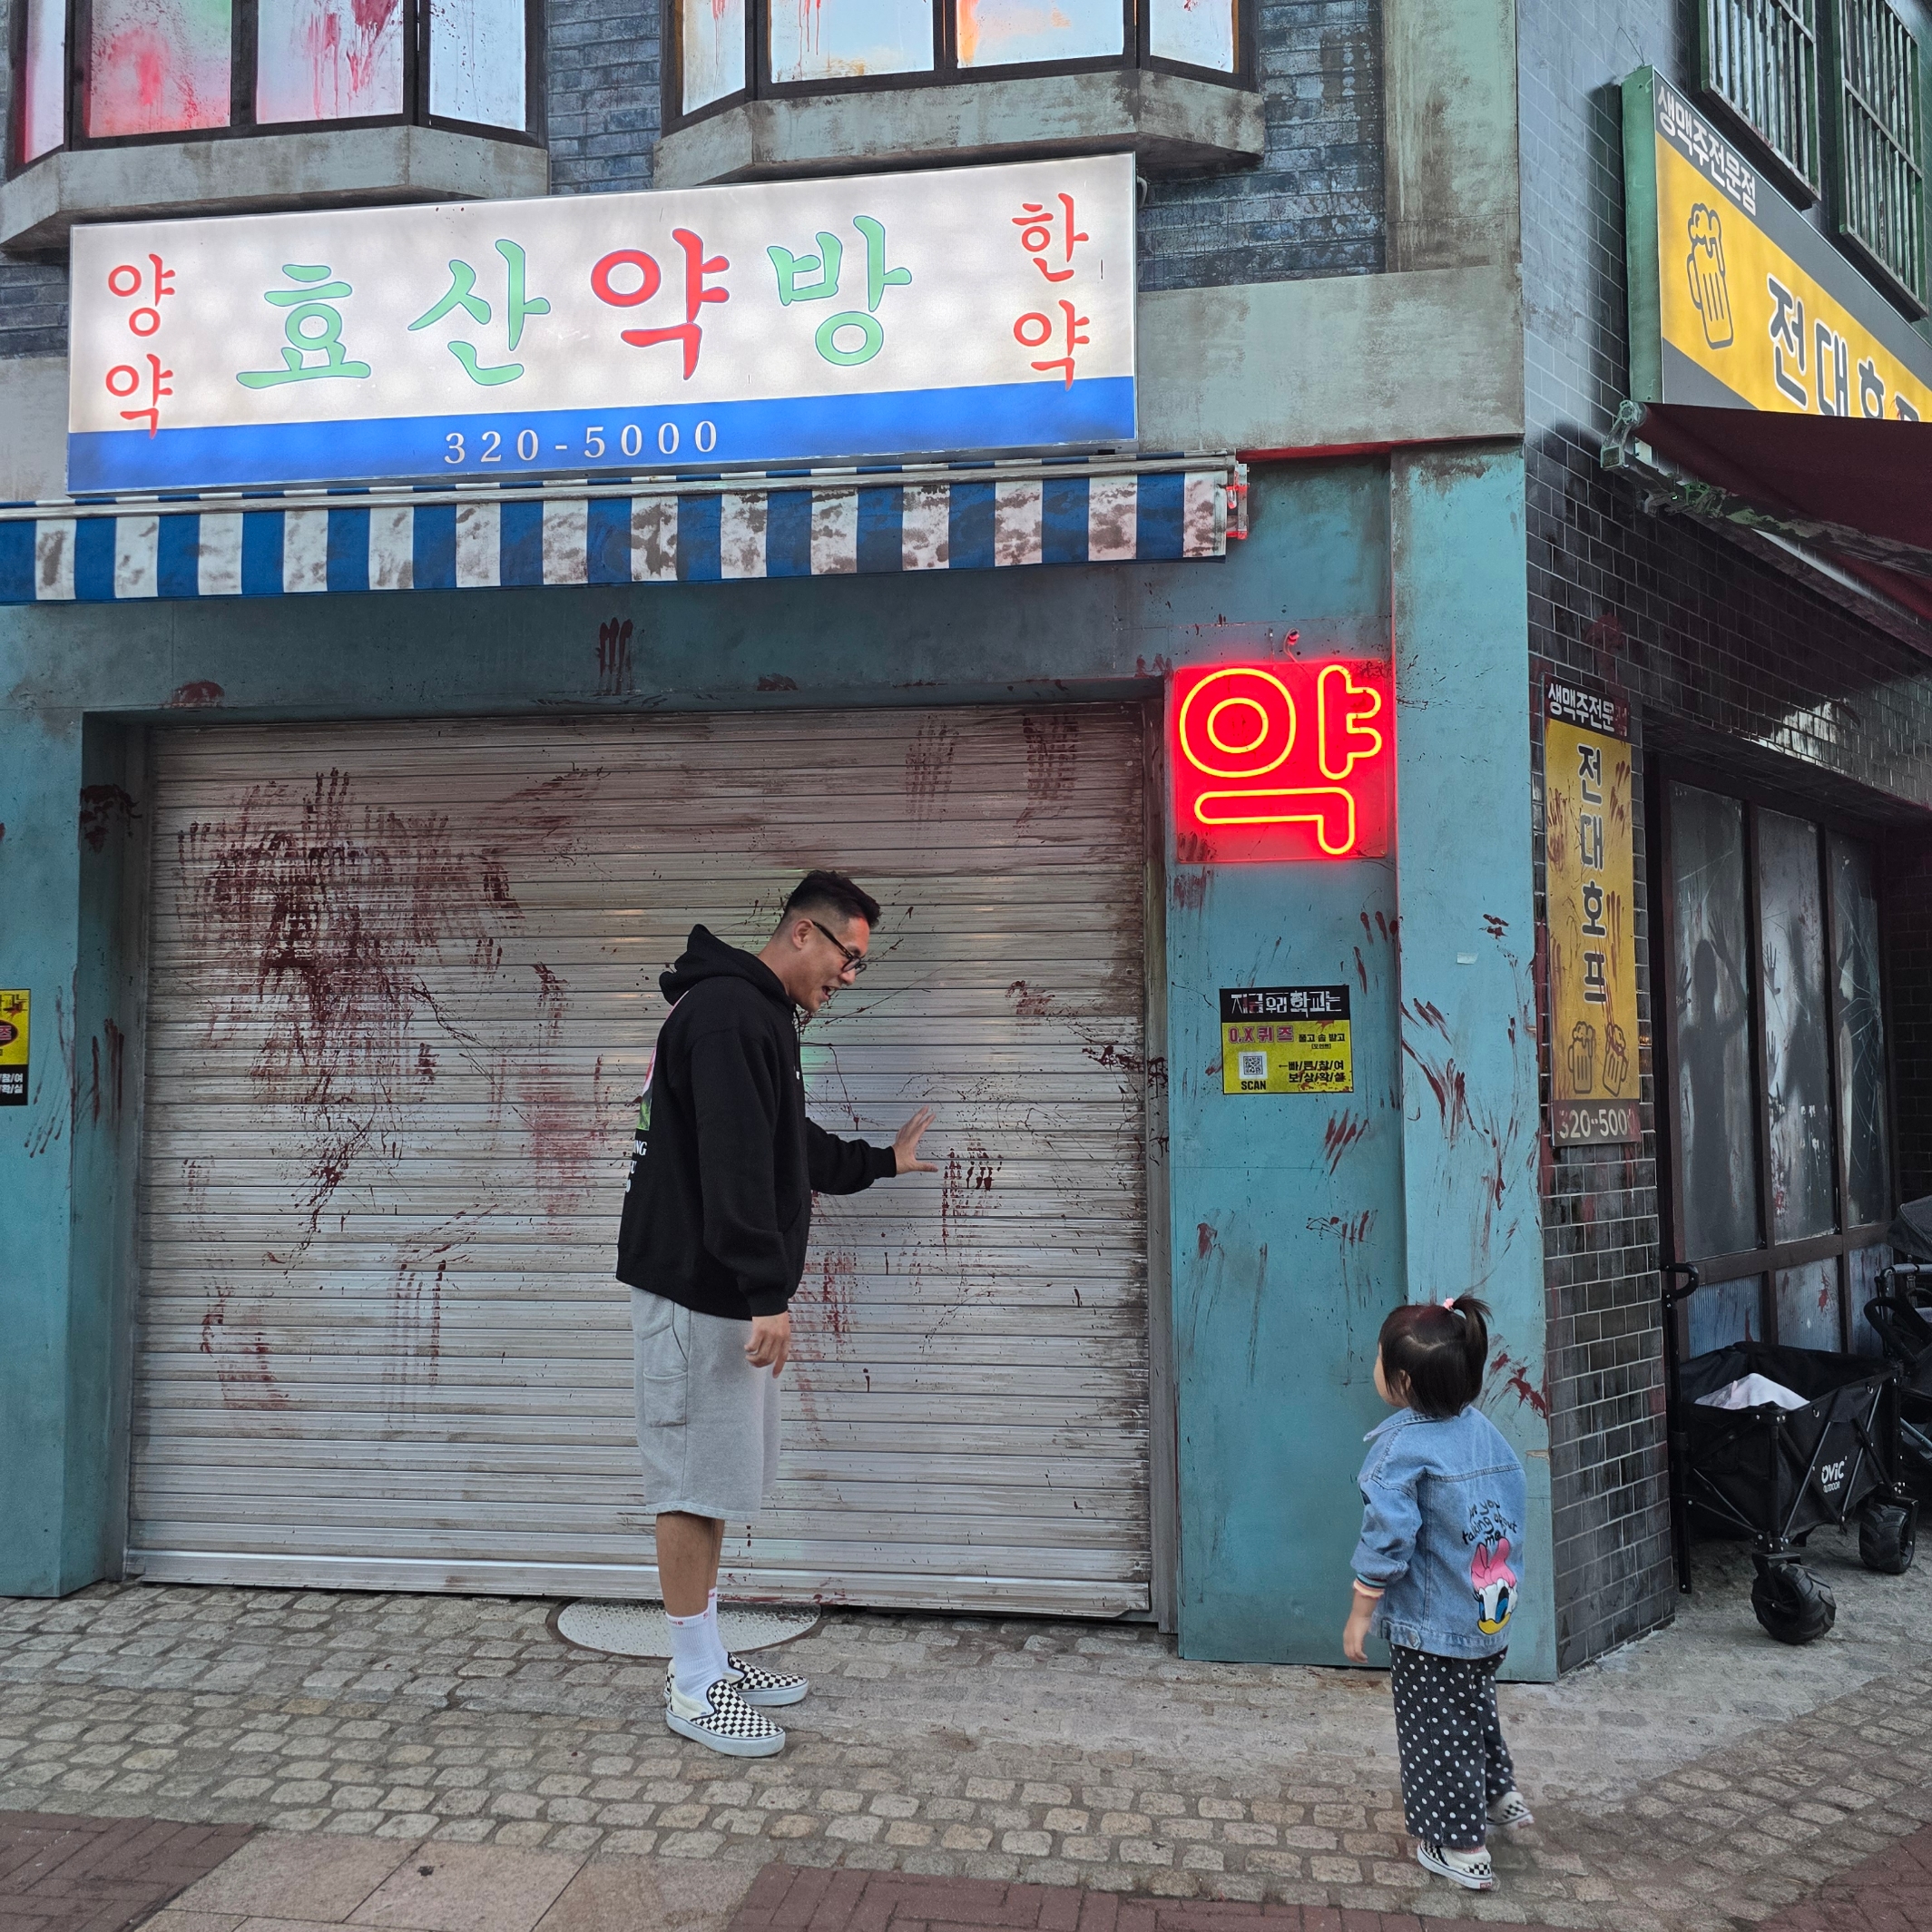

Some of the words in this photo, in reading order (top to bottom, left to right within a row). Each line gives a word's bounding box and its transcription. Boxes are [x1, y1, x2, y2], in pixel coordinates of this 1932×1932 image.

[1658, 86, 1756, 217] 생맥주전문점
[236, 215, 912, 389] 효산약방
[444, 420, 718, 465] 320-5000
[1179, 664, 1382, 855] 약
[1577, 742, 1607, 1003] 전대호프
[1231, 993, 1264, 1015] 지금
[1290, 990, 1342, 1018] 학교는
[1241, 1080, 1267, 1091] SCAN
[1462, 1516, 1495, 1545] talking
